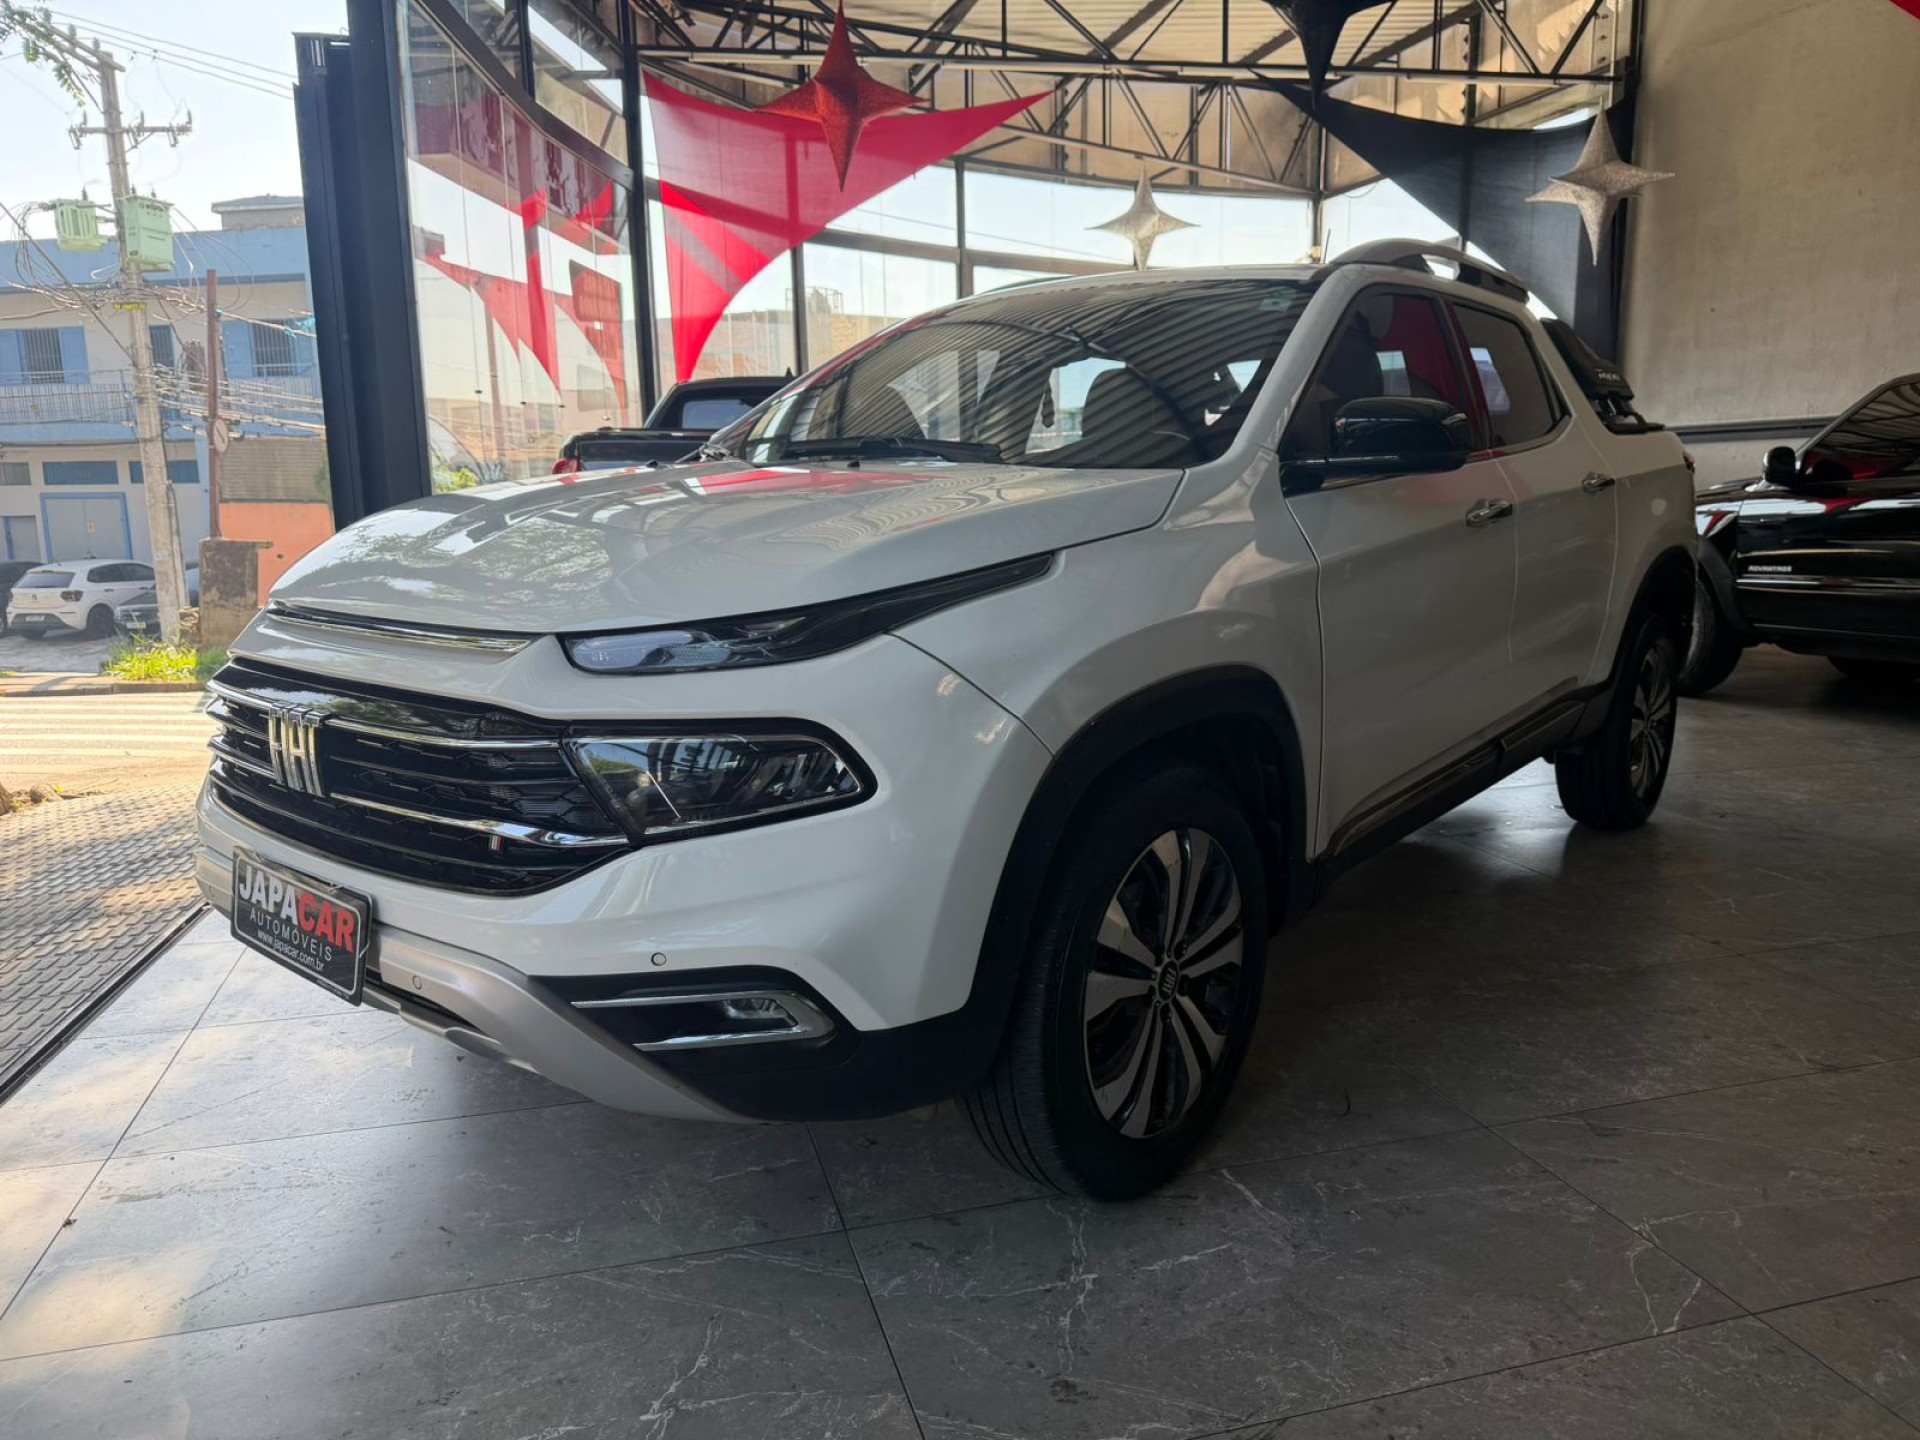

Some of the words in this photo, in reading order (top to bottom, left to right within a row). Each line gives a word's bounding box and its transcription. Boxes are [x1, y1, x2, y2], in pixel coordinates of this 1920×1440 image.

[268, 704, 325, 798] FIAT
[239, 864, 356, 954] JAPACAR
[250, 907, 333, 962] AUTOMÓVEIS
[257, 929, 326, 973] www.japacar.com.br
